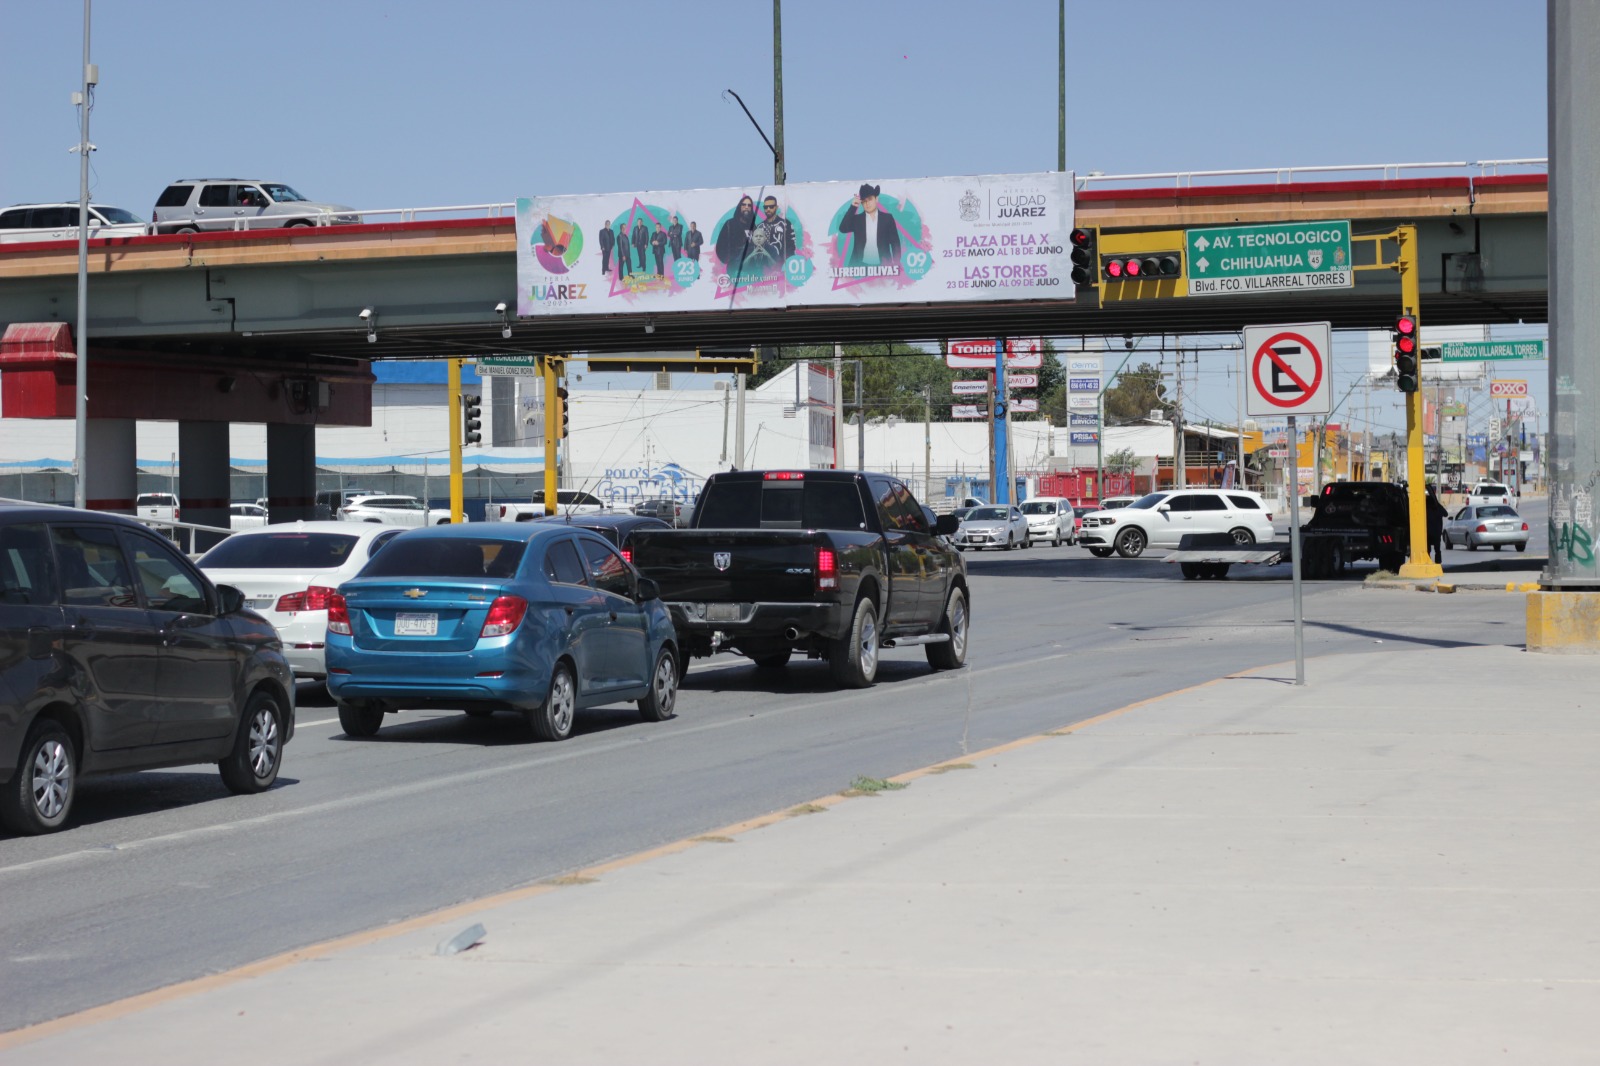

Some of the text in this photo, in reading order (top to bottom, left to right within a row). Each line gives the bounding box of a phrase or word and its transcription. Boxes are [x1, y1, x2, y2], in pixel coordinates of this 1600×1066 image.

[997, 195, 1046, 206] CIUDAD
[998, 205, 1046, 218] JUÁREZ
[956, 234, 1049, 248] PLAZA DE LA X
[1213, 230, 1342, 248] AV. TECNOLOGICO
[942, 250, 953, 258] 25
[968, 248, 994, 256] MAYO
[997, 248, 1008, 256] AL
[1022, 247, 1033, 255] DE
[1036, 246, 1063, 254] JUNIO
[788, 259, 805, 274] 01
[906, 252, 926, 267] 09
[1220, 254, 1303, 270] CHIHUAHUA
[677, 261, 695, 275] 23
[830, 266, 898, 278] ALFREDO OLIVAS
[964, 264, 1047, 279] LAS TORRES
[1196, 273, 1345, 292] Blvd. FCO. VILLARREAL TORRES
[528, 282, 588, 301] JUÁREZ
[1444, 344, 1538, 358] FRANCISCO VILLARREAL TORRES
[1492, 383, 1526, 394] OXXO
[605, 467, 649, 480] POLO'S
[597, 480, 639, 504] Car
